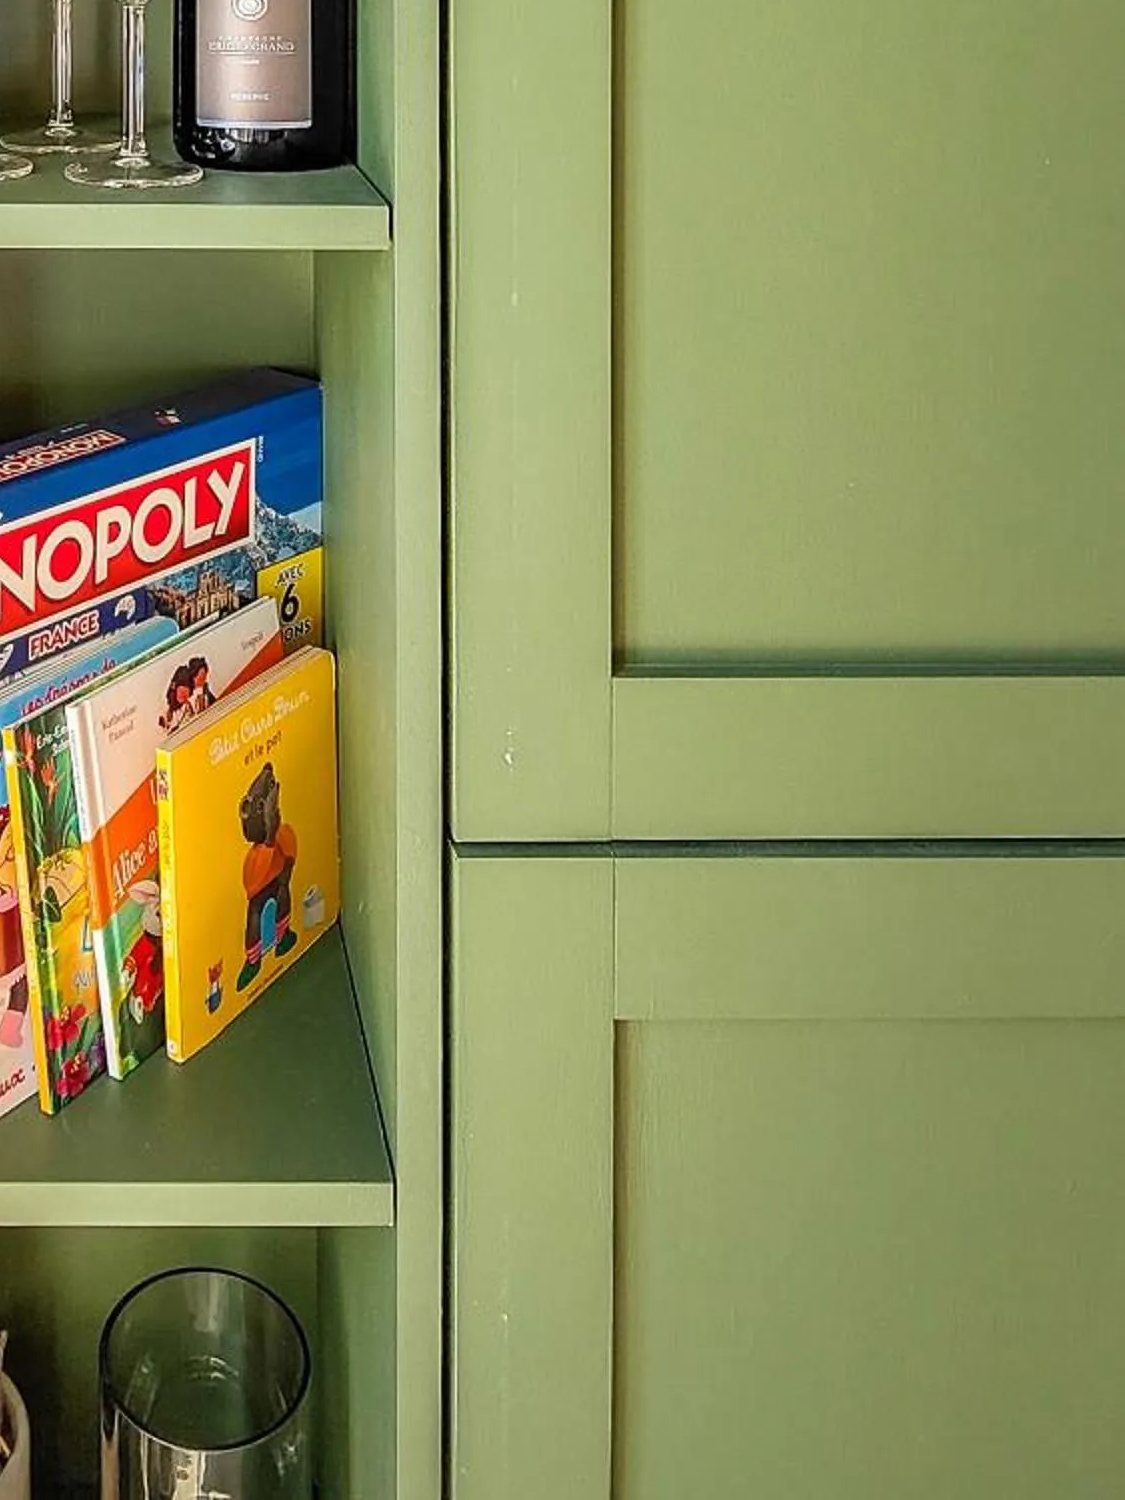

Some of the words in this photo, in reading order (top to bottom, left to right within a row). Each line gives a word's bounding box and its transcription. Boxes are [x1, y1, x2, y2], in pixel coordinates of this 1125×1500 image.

[281, 583, 299, 622] 6
[28, 610, 100, 660] FRANCE
[284, 620, 312, 641] ONS
